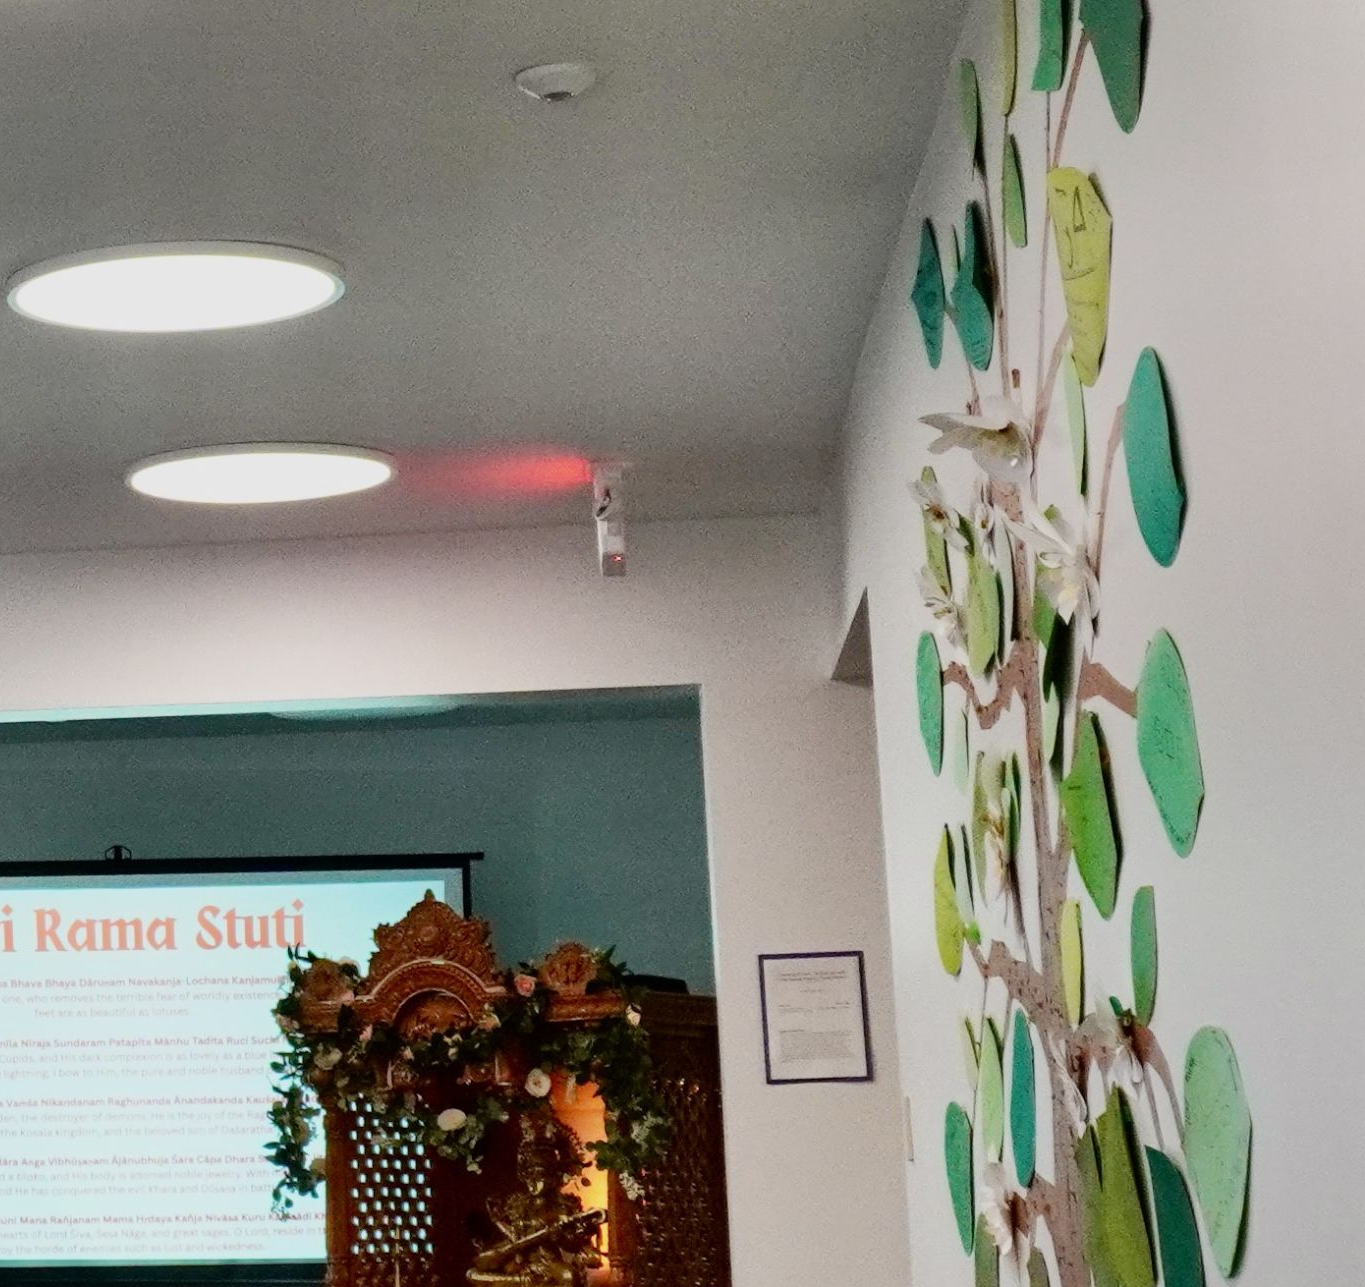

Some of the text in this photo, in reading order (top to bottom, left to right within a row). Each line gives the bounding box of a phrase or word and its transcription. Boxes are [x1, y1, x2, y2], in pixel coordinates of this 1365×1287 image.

[34, 908, 178, 952] Rama
[195, 898, 307, 951] Stuti
[26, 993, 48, 1003] who
[50, 993, 95, 1003] removes
[96, 992, 114, 1002] the
[116, 991, 154, 1002] terrible
[156, 991, 177, 1001] fear
[179, 991, 191, 1001] of
[192, 990, 230, 1003] worldly
[34, 1006, 149, 1018] feet are as beautiful as
[53, 1037, 106, 1048] Sundaram
[38, 1052, 58, 1063] and
[79, 1052, 101, 1062] dark
[104, 1051, 164, 1064] complexion
[176, 1052, 187, 1061] as
[189, 1050, 220, 1063] lovely
[223, 1052, 234, 1060] as
[58, 1067, 80, 1077] bow
[82, 1067, 95, 1077] to
[121, 1066, 139, 1077] the
[141, 1066, 165, 1078] pure
[167, 1065, 187, 1076] and
[188, 1065, 218, 1076] noble
[220, 1064, 264, 1075] husband
[20, 1112, 38, 1122] the
[40, 1111, 89, 1124] destroyer
[92, 1111, 104, 1121] of
[150, 1110, 165, 1121] He
[177, 1110, 195, 1120] the
[197, 1109, 212, 1122] joy
[214, 1109, 226, 1120] of
[227, 1109, 245, 1119] the
[0, 1127, 17, 1137] the
[103, 1126, 122, 1136] and
[125, 1125, 142, 1136] the
[144, 1125, 185, 1136] beloved
[187, 1126, 207, 1135] son
[209, 1124, 220, 1135] of
[50, 1170, 70, 1181] and
[90, 1170, 116, 1183] body
[118, 1170, 126, 1180] is
[129, 1169, 171, 1180] adorned
[173, 1169, 202, 1180] noble
[14, 1185, 29, 1196] He
[31, 1185, 49, 1196] has
[51, 1184, 106, 1197] conquered
[108, 1184, 126, 1195] the
[128, 1184, 145, 1194] evil
[179, 1183, 199, 1194] and
[239, 1183, 248, 1193] in
[30, 1229, 42, 1239] of
[44, 1229, 67, 1239] Lord
[150, 1227, 170, 1238] and
[172, 1227, 199, 1240] great
[273, 1226, 304, 1237] reside
[15, 1244, 33, 1254] the
[35, 1243, 64, 1254] horde
[66, 1243, 78, 1254] of
[79, 1243, 123, 1254] enemies
[124, 1242, 149, 1253] such
[150, 1244, 161, 1253] as
[185, 1241, 204, 1252] and
